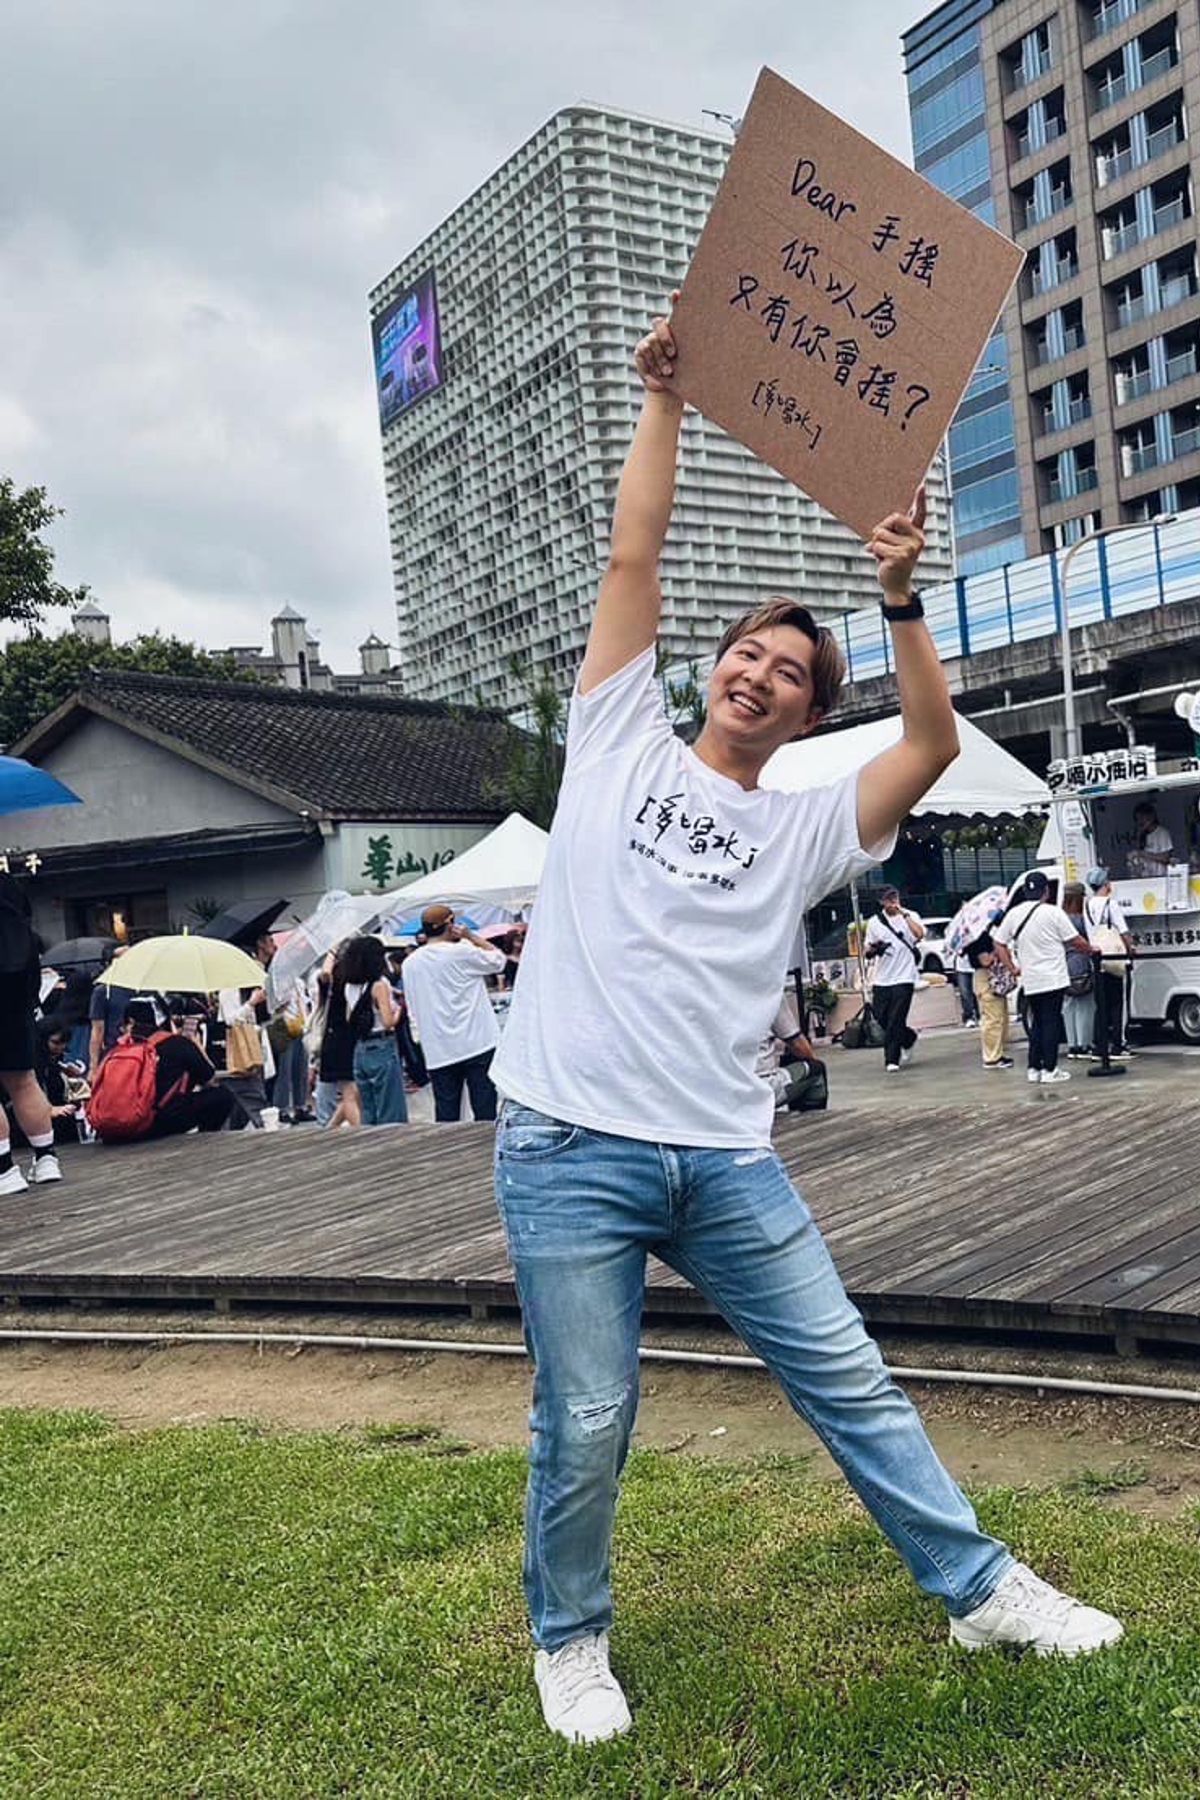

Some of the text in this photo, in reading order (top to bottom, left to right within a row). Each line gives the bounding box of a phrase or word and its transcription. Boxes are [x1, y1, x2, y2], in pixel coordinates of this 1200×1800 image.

[789, 157, 940, 289] Dear 手搖
[779, 237, 898, 340] 你以為
